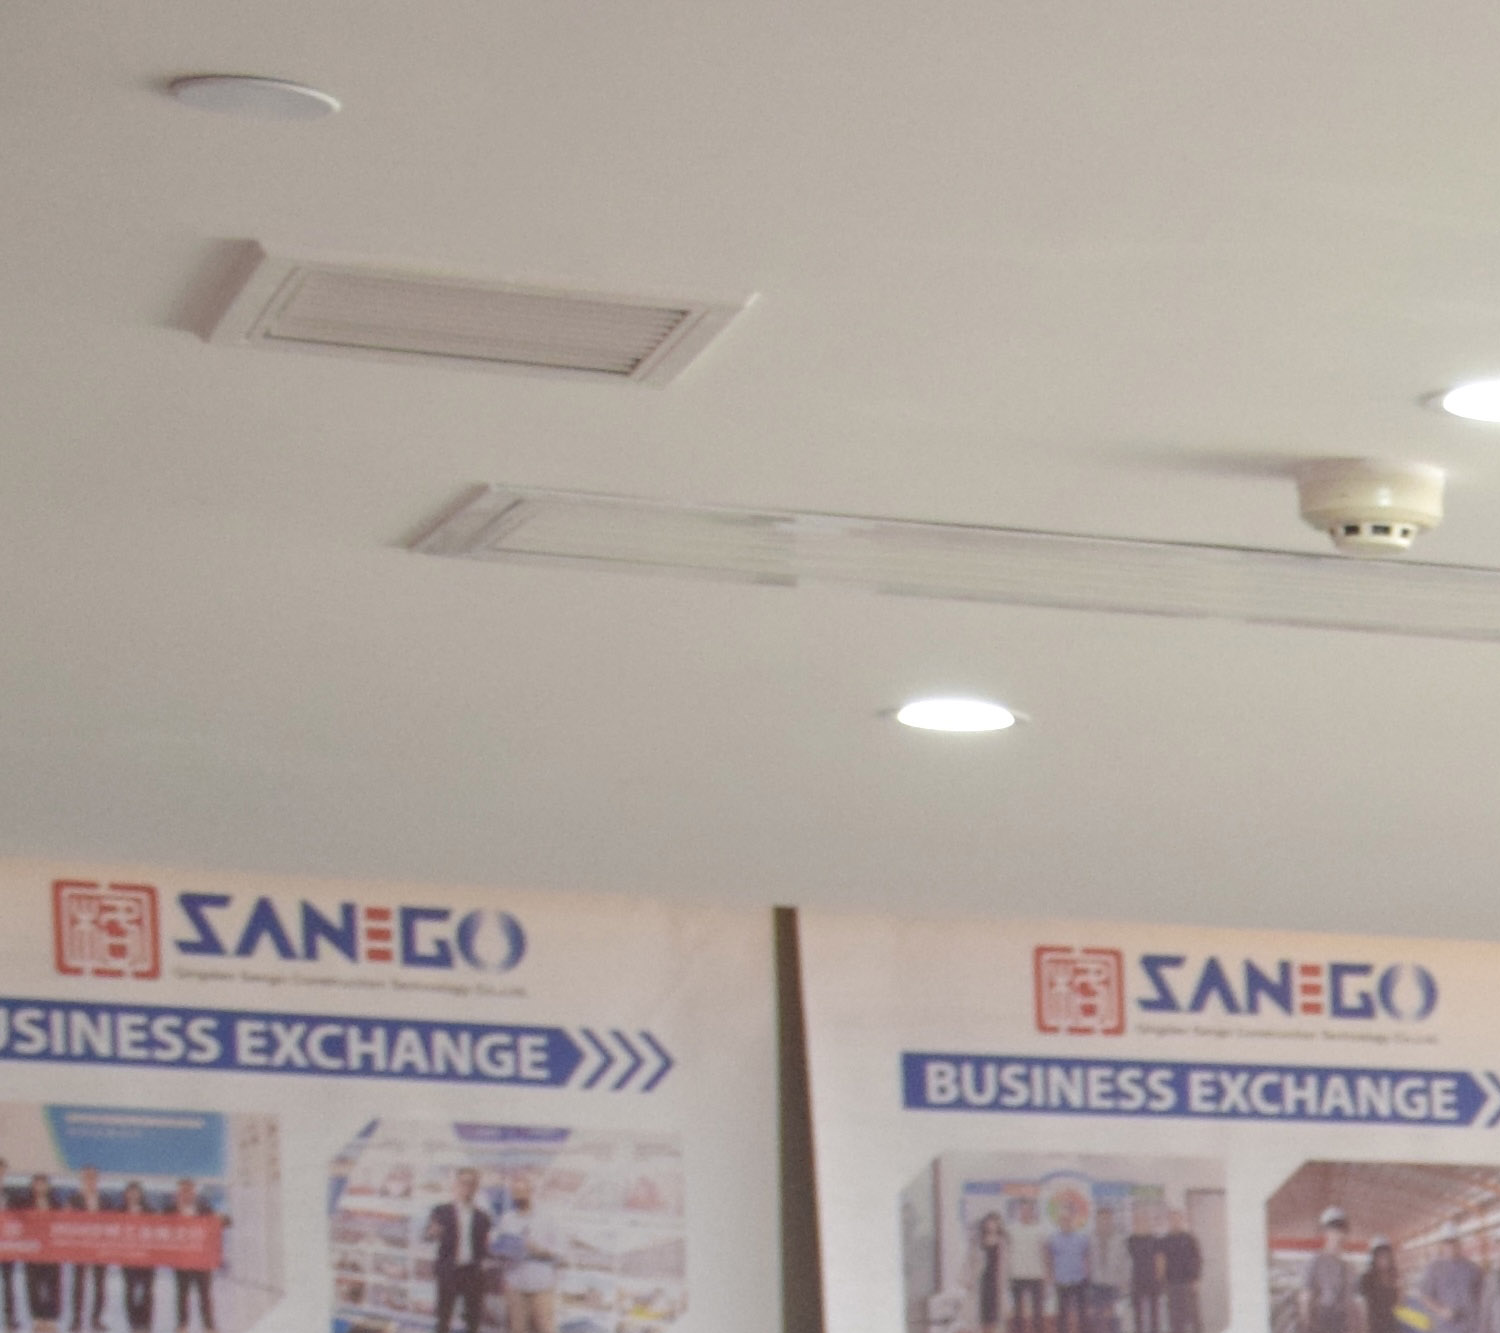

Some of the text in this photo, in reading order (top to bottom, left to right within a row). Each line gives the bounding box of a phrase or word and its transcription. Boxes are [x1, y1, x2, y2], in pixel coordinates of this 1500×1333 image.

[0, 1006, 551, 1080] SINESS EXCHANGE
[924, 1061, 1459, 1120] BUSINESS EXCHANGE
